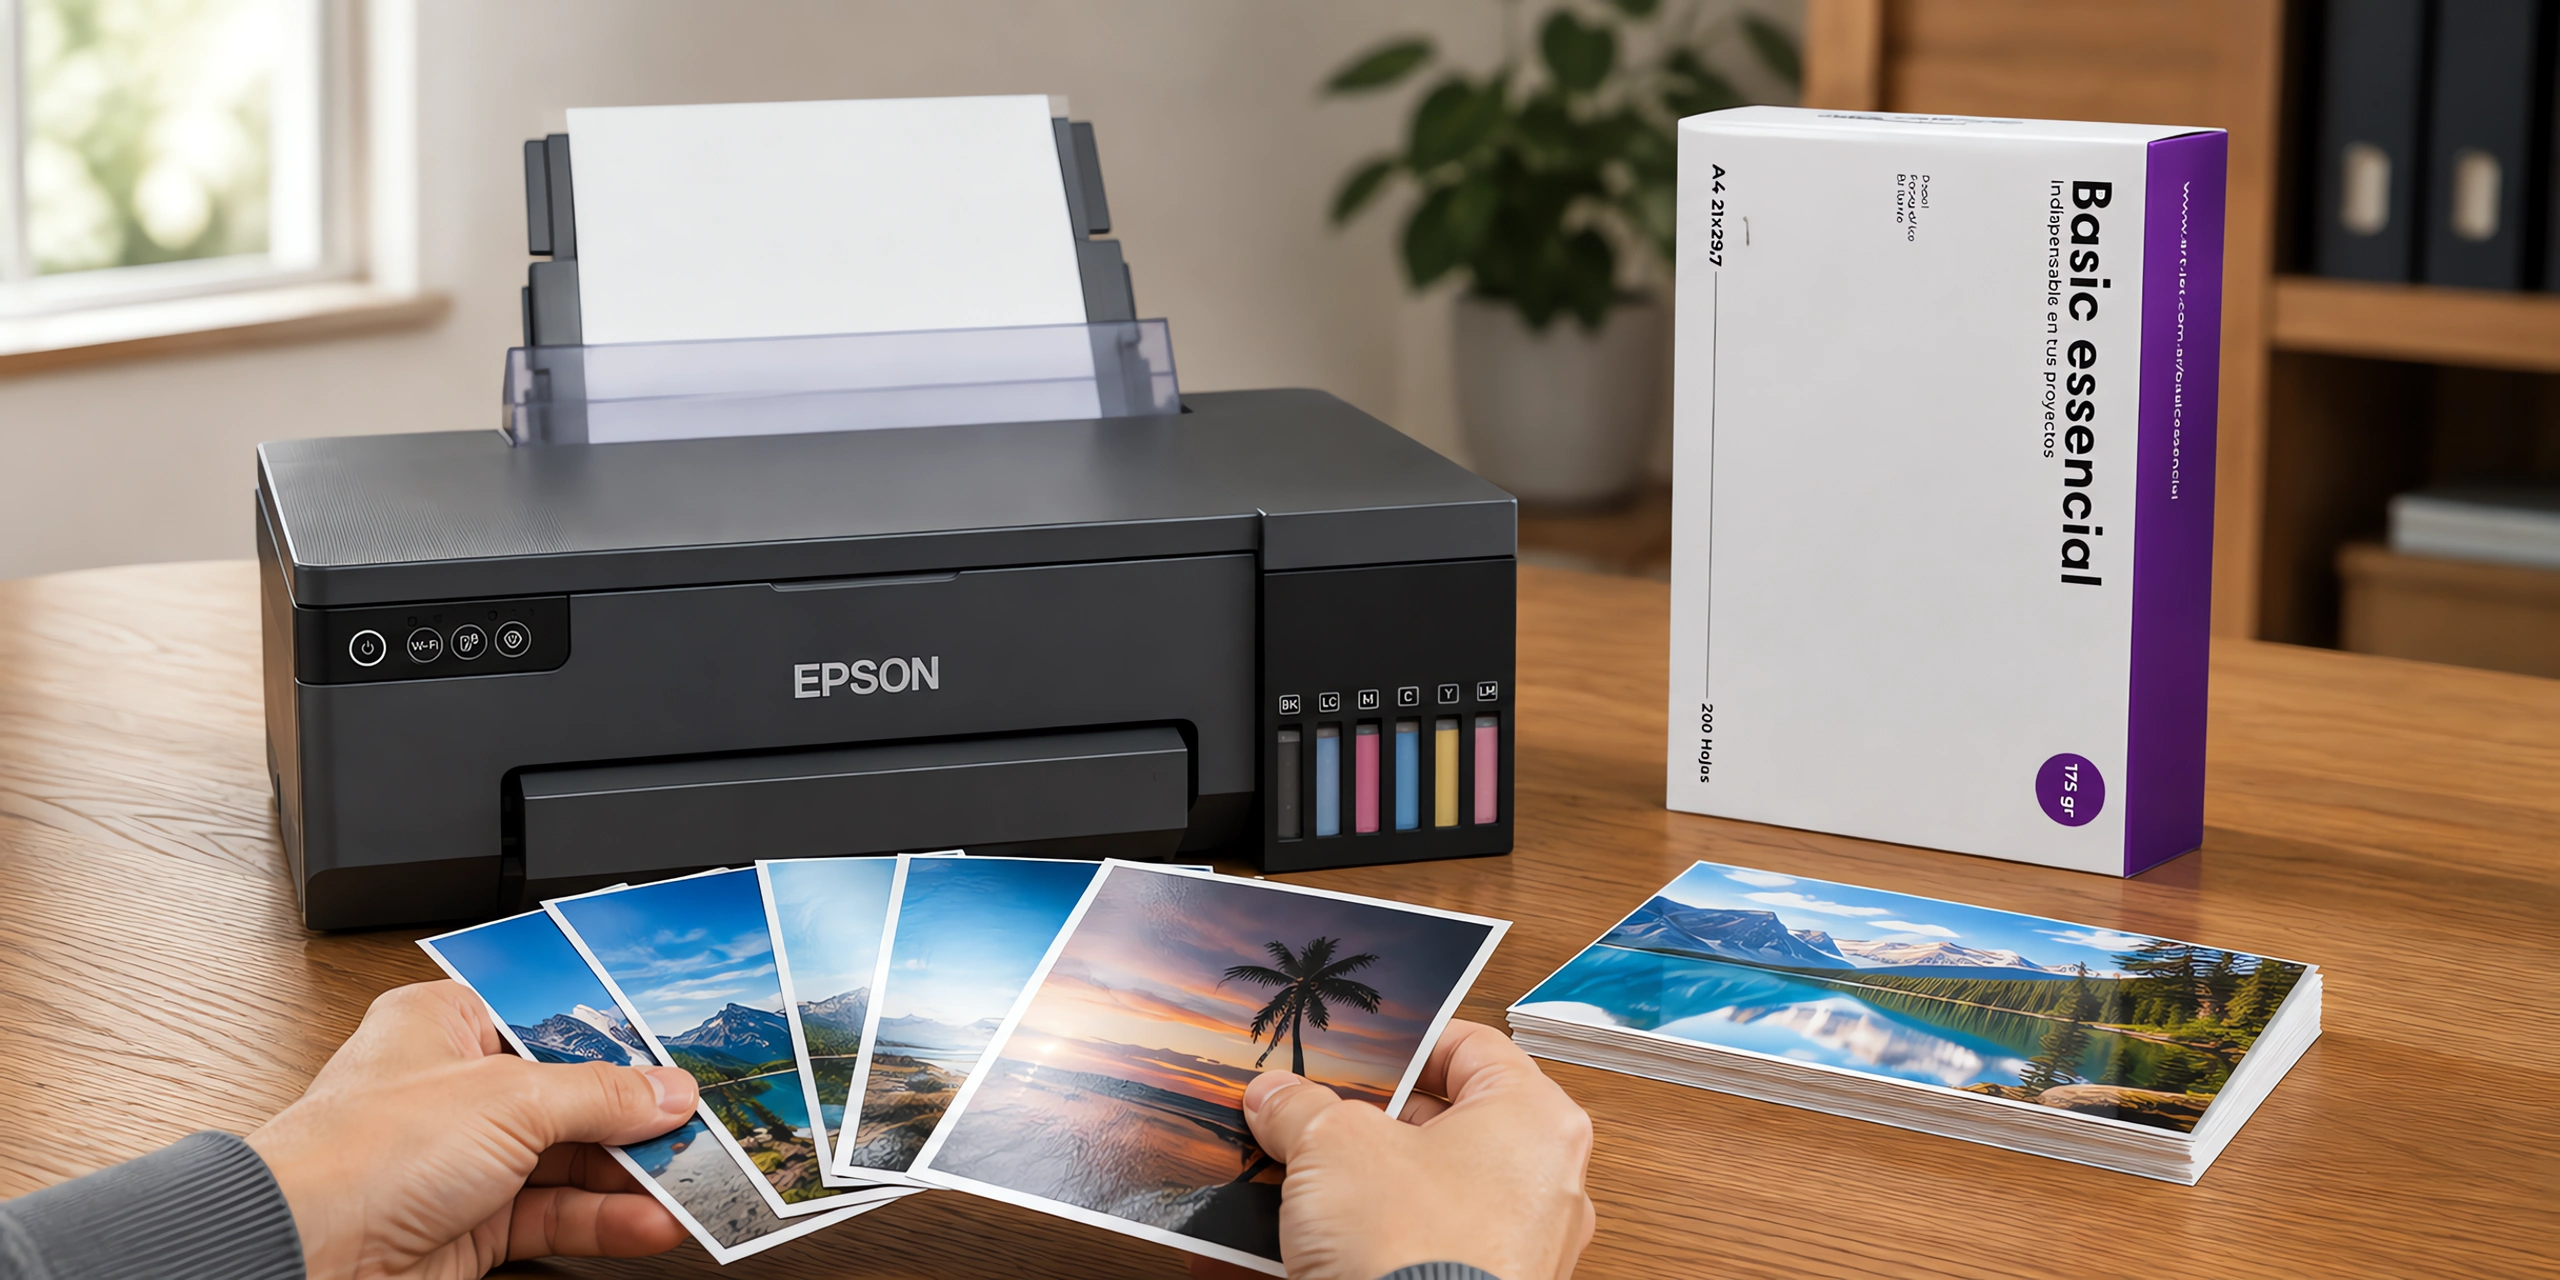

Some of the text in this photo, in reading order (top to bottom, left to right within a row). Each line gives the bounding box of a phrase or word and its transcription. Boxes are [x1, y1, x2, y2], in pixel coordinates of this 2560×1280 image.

[1709, 163, 1726, 268] A4 21x29,7
[2046, 311, 2058, 334] en
[2046, 338, 2059, 367] tus
[2060, 179, 2113, 587] Basic essencial
[2041, 371, 2057, 459] proyectos
[793, 655, 940, 699] EPSON
[1282, 699, 1299, 711] BK
[1322, 696, 1338, 708] LC
[1362, 693, 1374, 705] M
[1403, 691, 1413, 702] C
[1444, 688, 1454, 700] Y
[1702, 702, 1714, 734] 200
[2060, 763, 2079, 818] 175 gr
